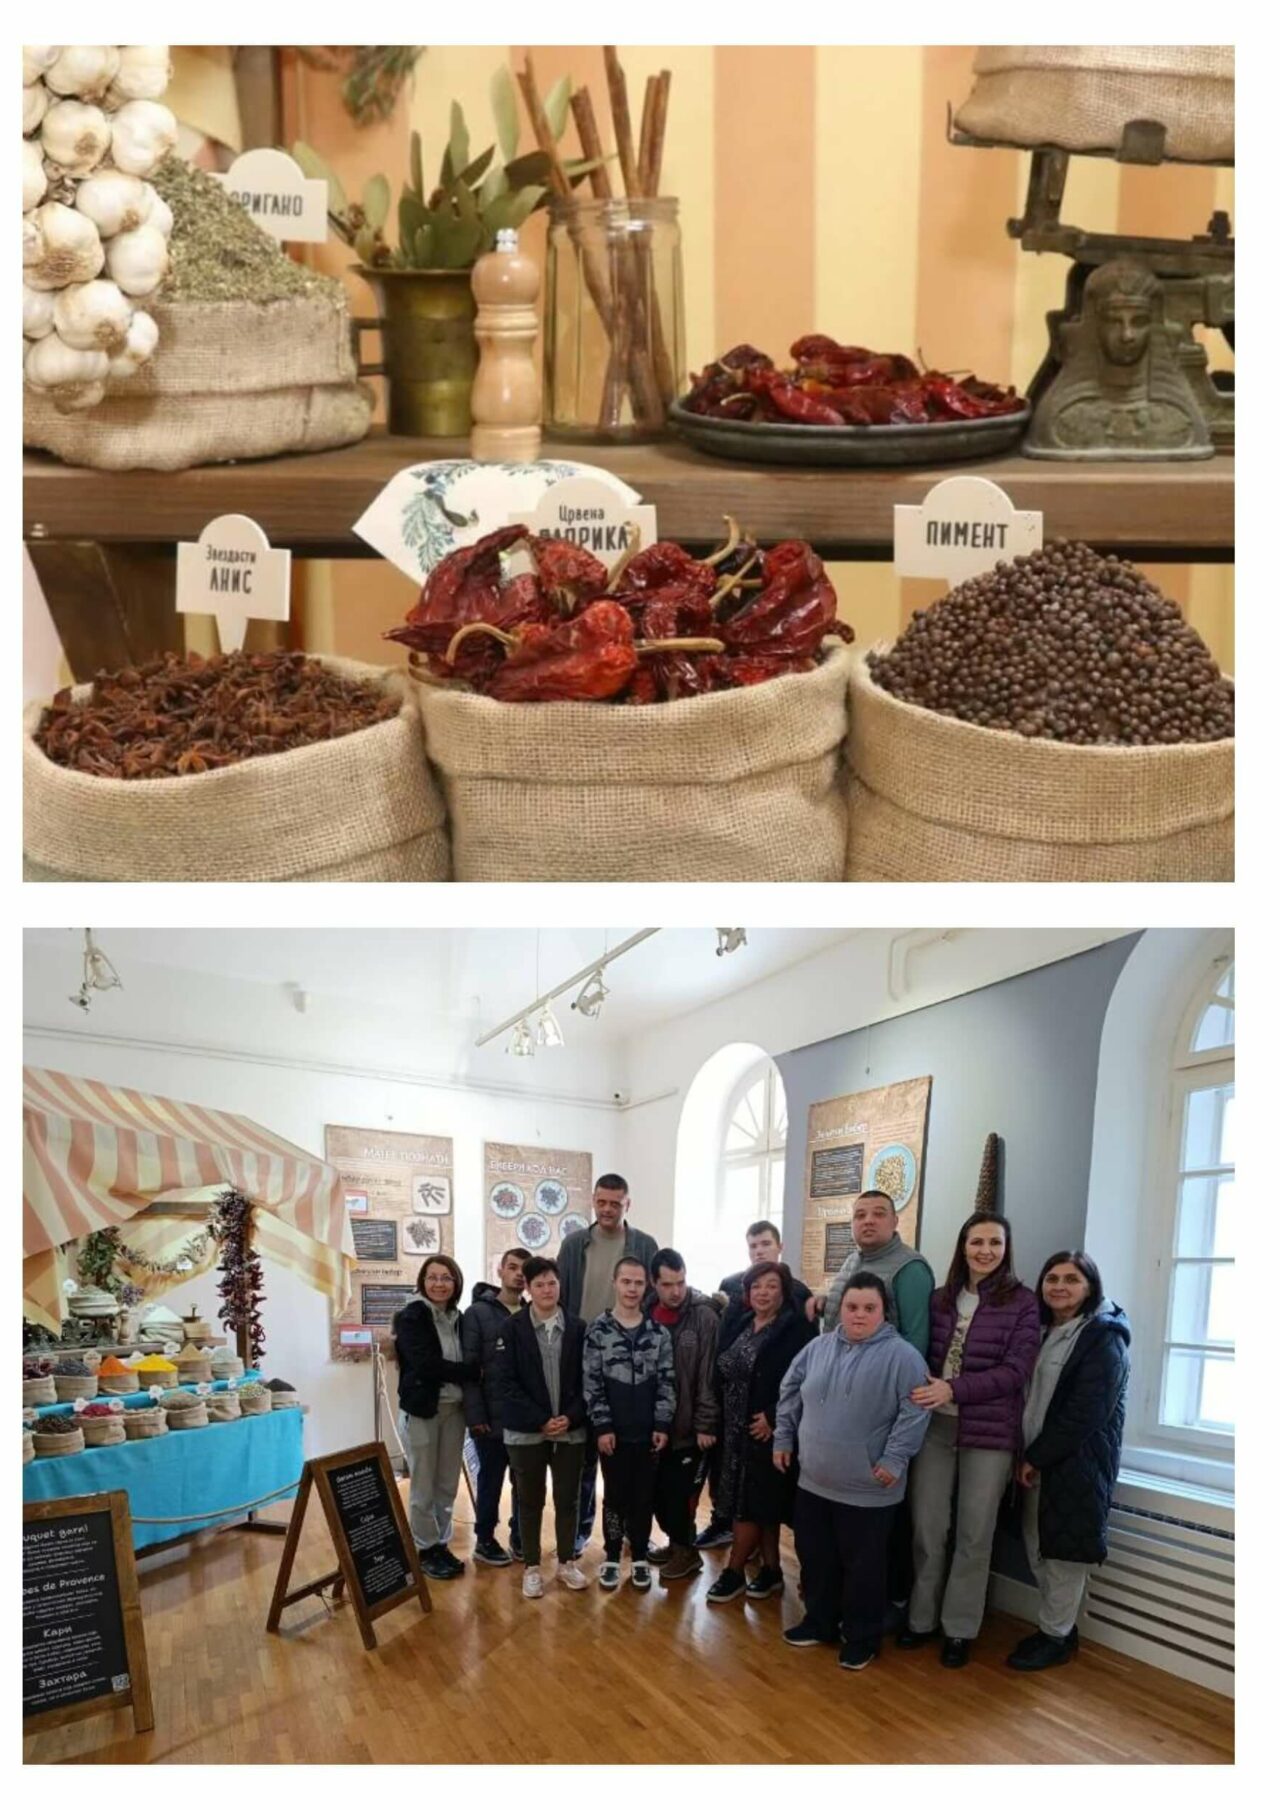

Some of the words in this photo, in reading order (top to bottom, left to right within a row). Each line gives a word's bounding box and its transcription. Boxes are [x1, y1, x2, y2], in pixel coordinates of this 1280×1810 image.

[559, 505, 605, 525] Црвена
[926, 521, 1009, 549] ПИМЕНТ
[206, 544, 257, 563] Звездасти
[210, 566, 252, 594] АНИС
[42, 1580, 56, 1592] de
[59, 1573, 106, 1588] Provence
[43, 1625, 73, 1638] Кари
[38, 1670, 88, 1689] Захтара
